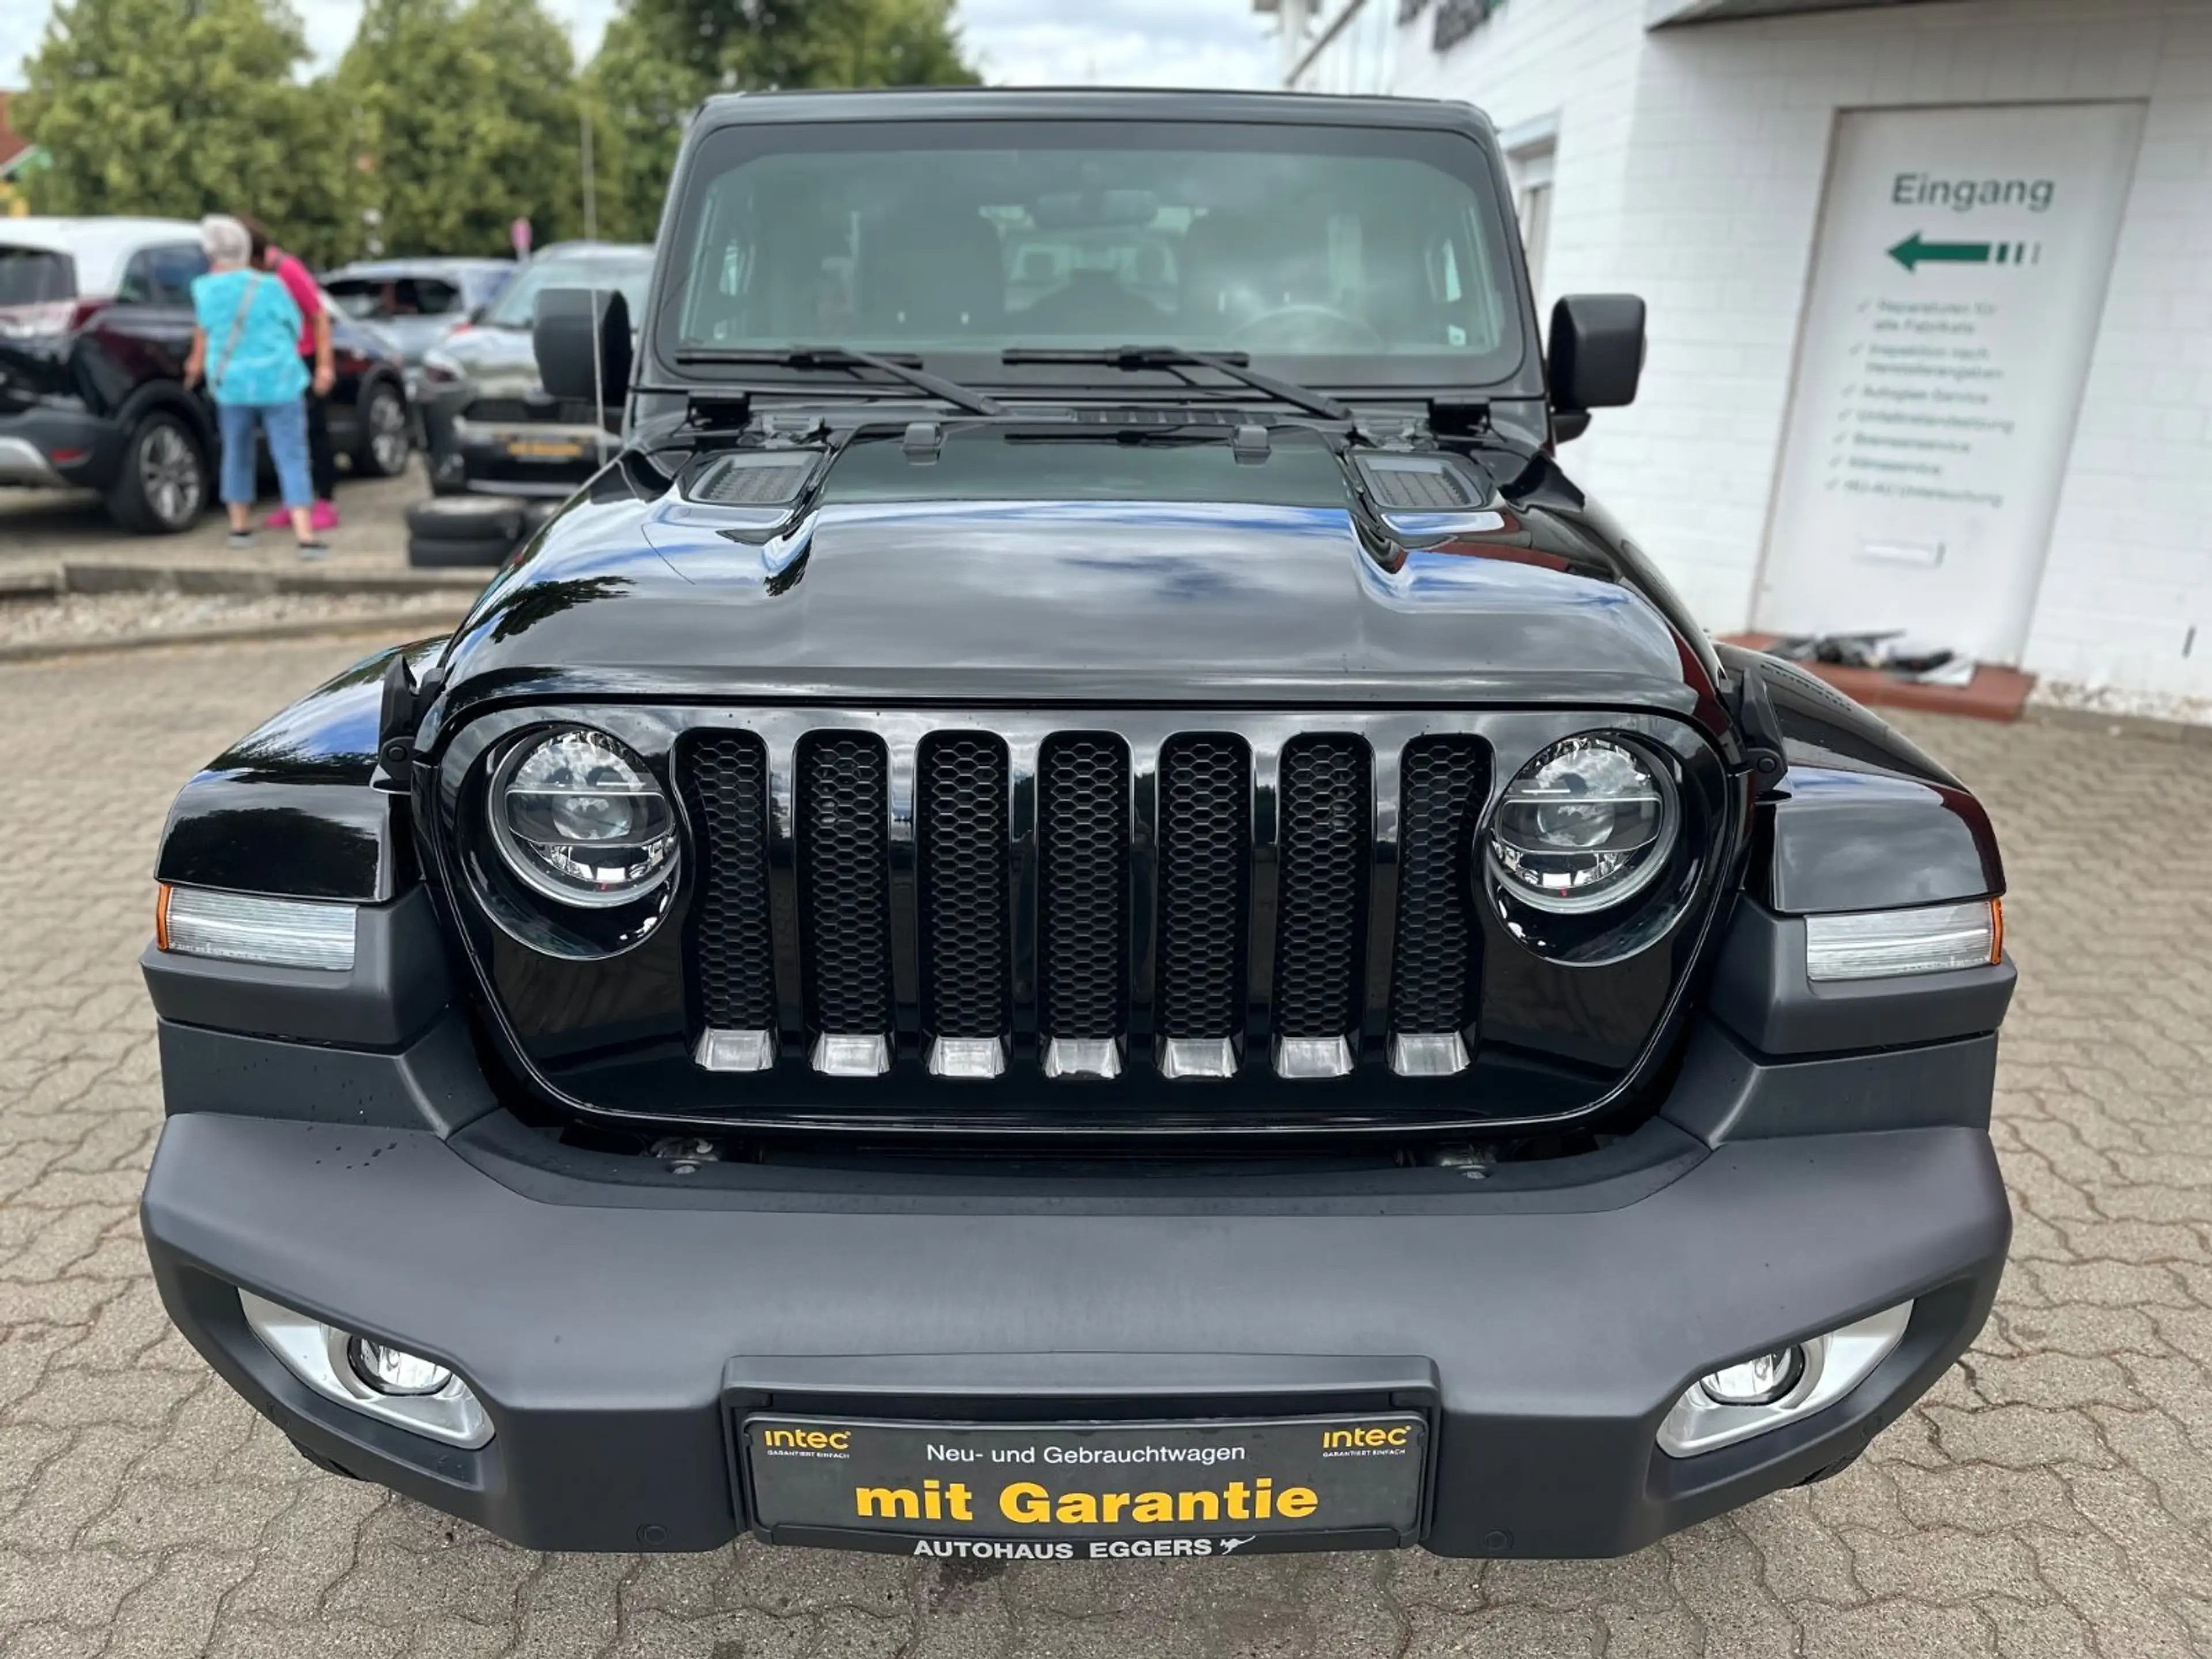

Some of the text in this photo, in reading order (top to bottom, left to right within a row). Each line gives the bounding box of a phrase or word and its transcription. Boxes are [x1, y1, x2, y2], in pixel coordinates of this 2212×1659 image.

[1891, 172, 2054, 213] Eingang
[926, 1444, 1245, 1465] Neu- und Gebrauchtwagen
[1323, 1449, 1370, 1458] GARANTIERT
[855, 1477, 1319, 1524] mit Garantie
[914, 1538, 1213, 1560] AUTOHAUS EGGERS
